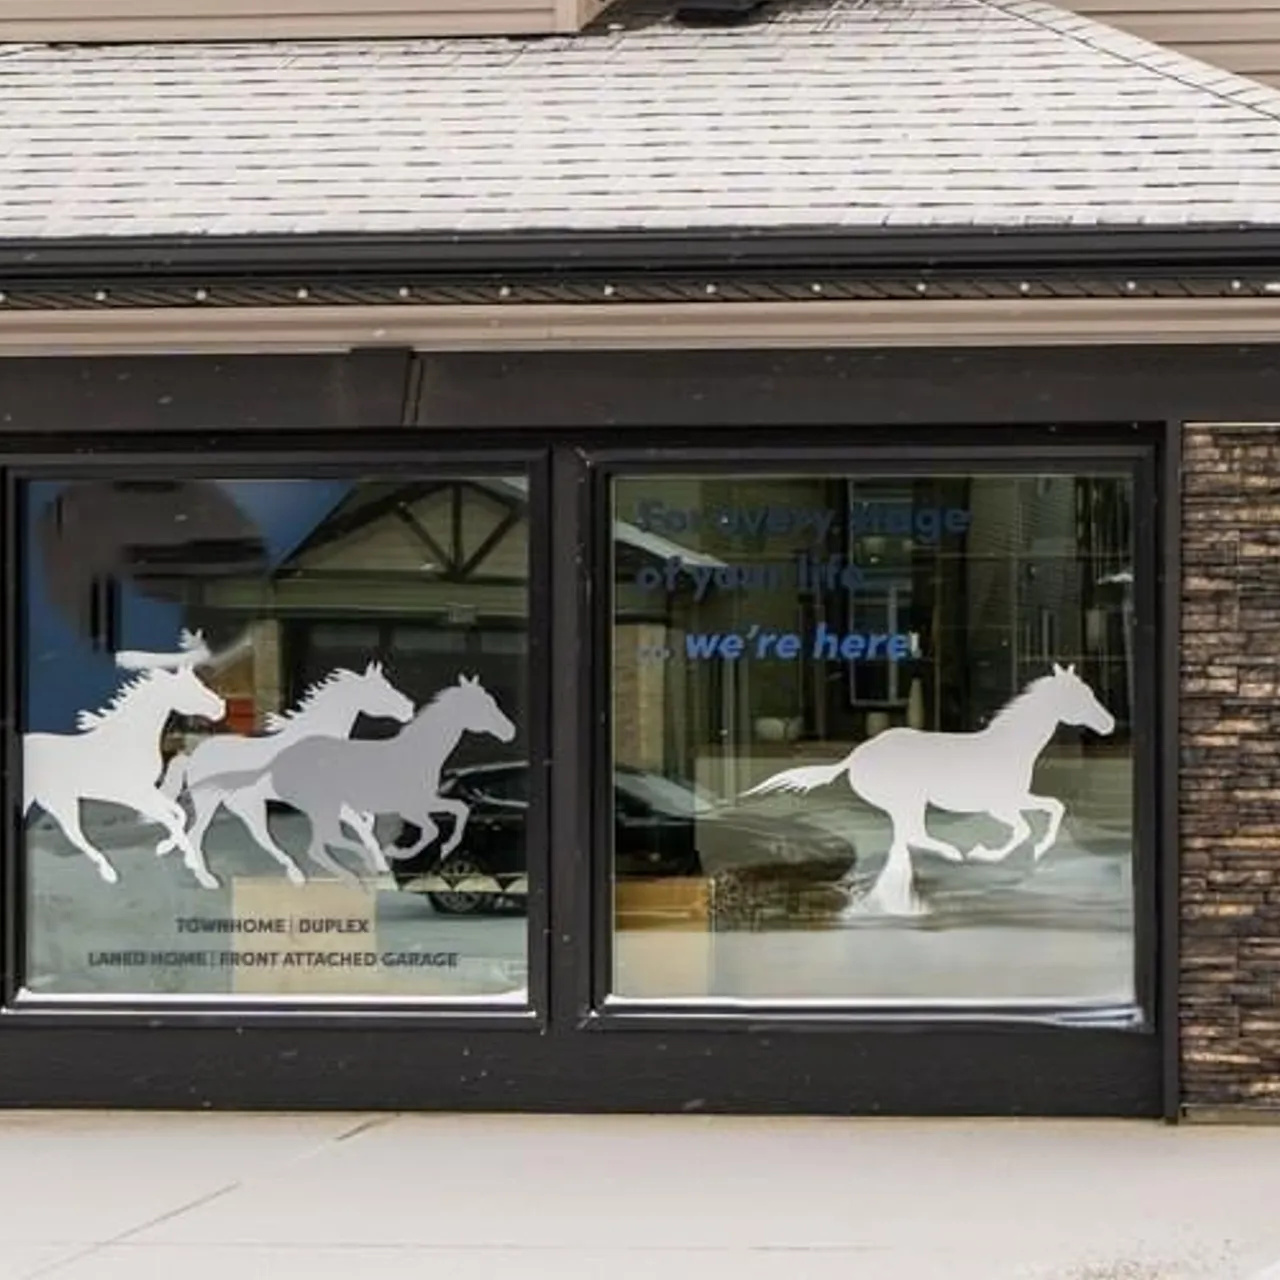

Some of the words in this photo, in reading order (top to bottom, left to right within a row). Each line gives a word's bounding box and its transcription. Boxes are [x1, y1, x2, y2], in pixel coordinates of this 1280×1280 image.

[635, 556, 682, 592] of
[175, 918, 286, 934] TOWNHOME
[299, 918, 370, 934] DUPLEX
[150, 951, 208, 967] HOME
[220, 951, 279, 967] FRONT
[283, 951, 377, 967] ATTACHED
[381, 951, 460, 967] GARAGE
